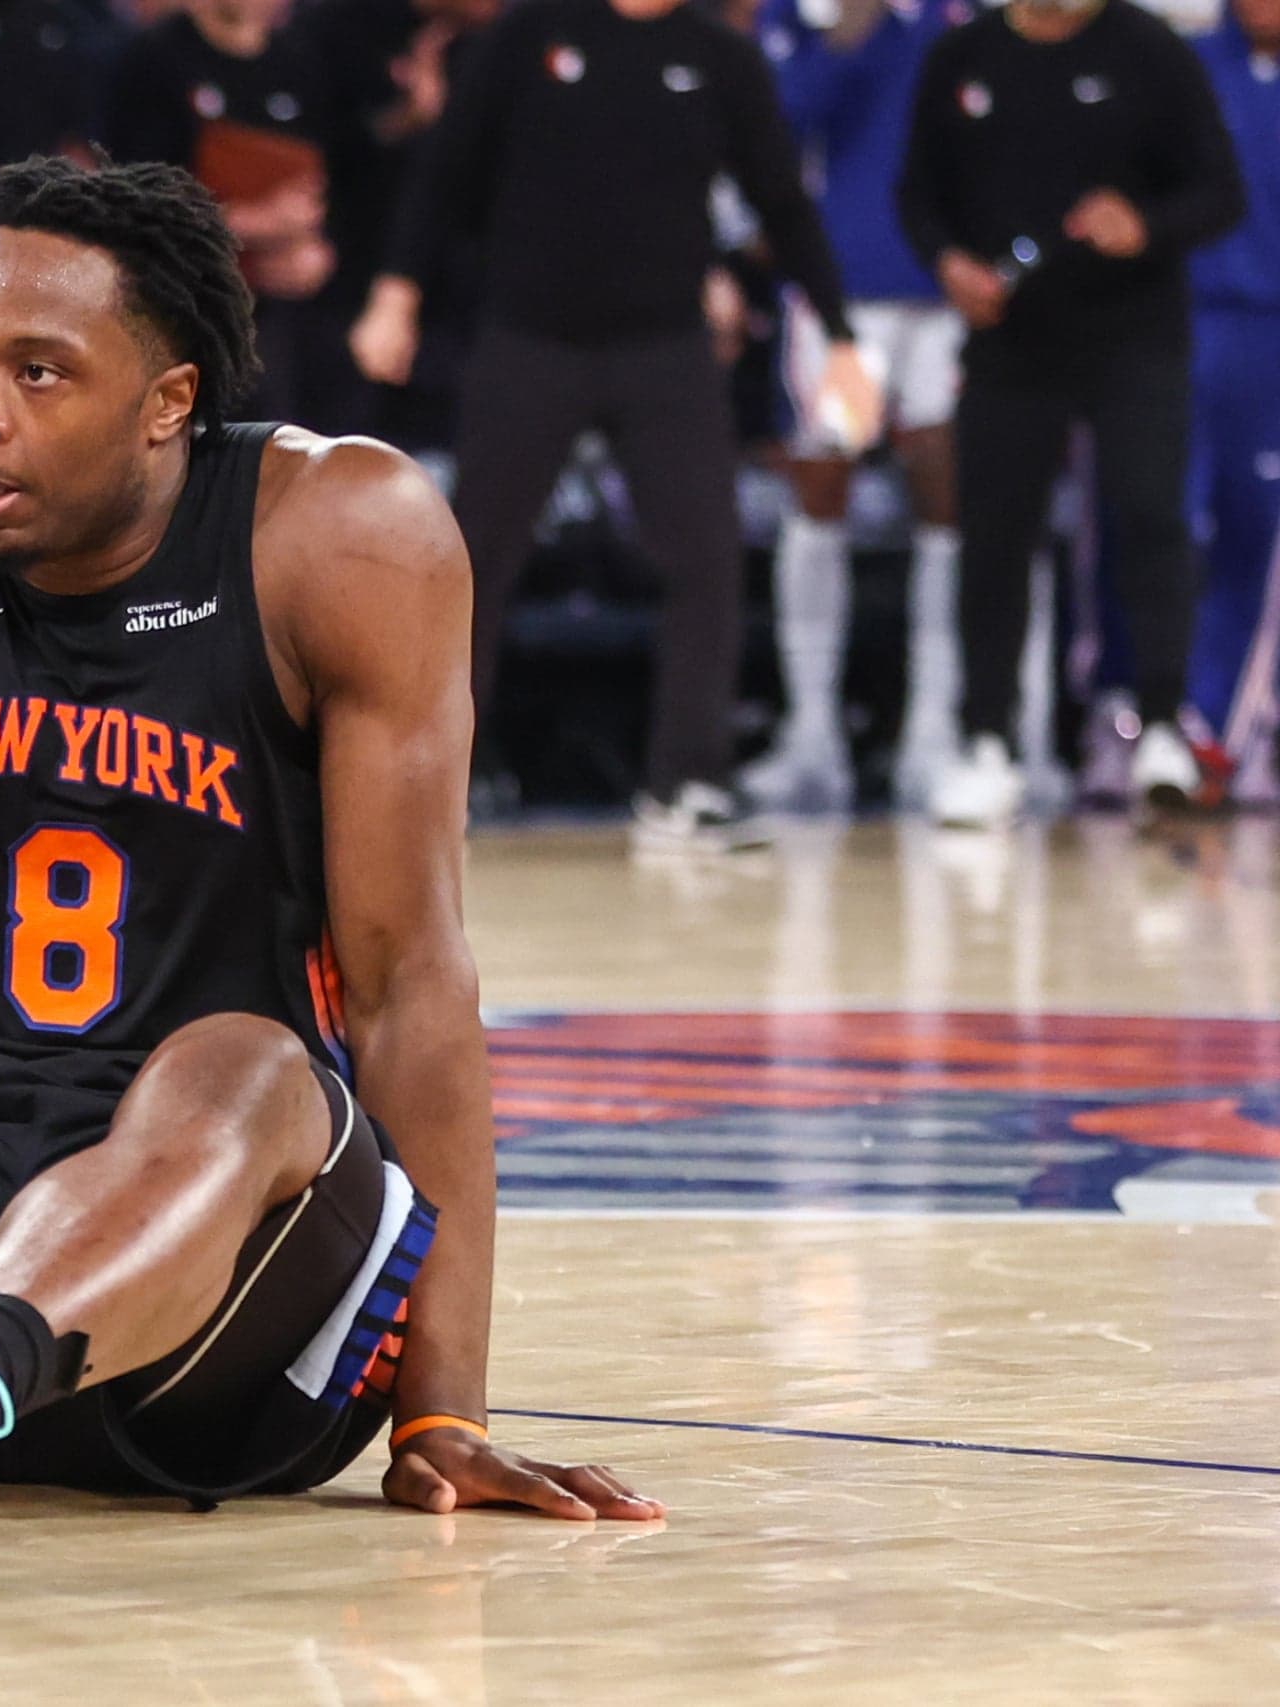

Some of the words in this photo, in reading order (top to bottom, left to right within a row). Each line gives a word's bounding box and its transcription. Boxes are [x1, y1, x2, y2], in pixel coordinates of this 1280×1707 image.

[125, 614, 166, 633] abu
[168, 595, 218, 628] dhabi
[126, 600, 183, 615] experience
[52, 701, 244, 832] YORK
[3, 821, 131, 1035] 8
